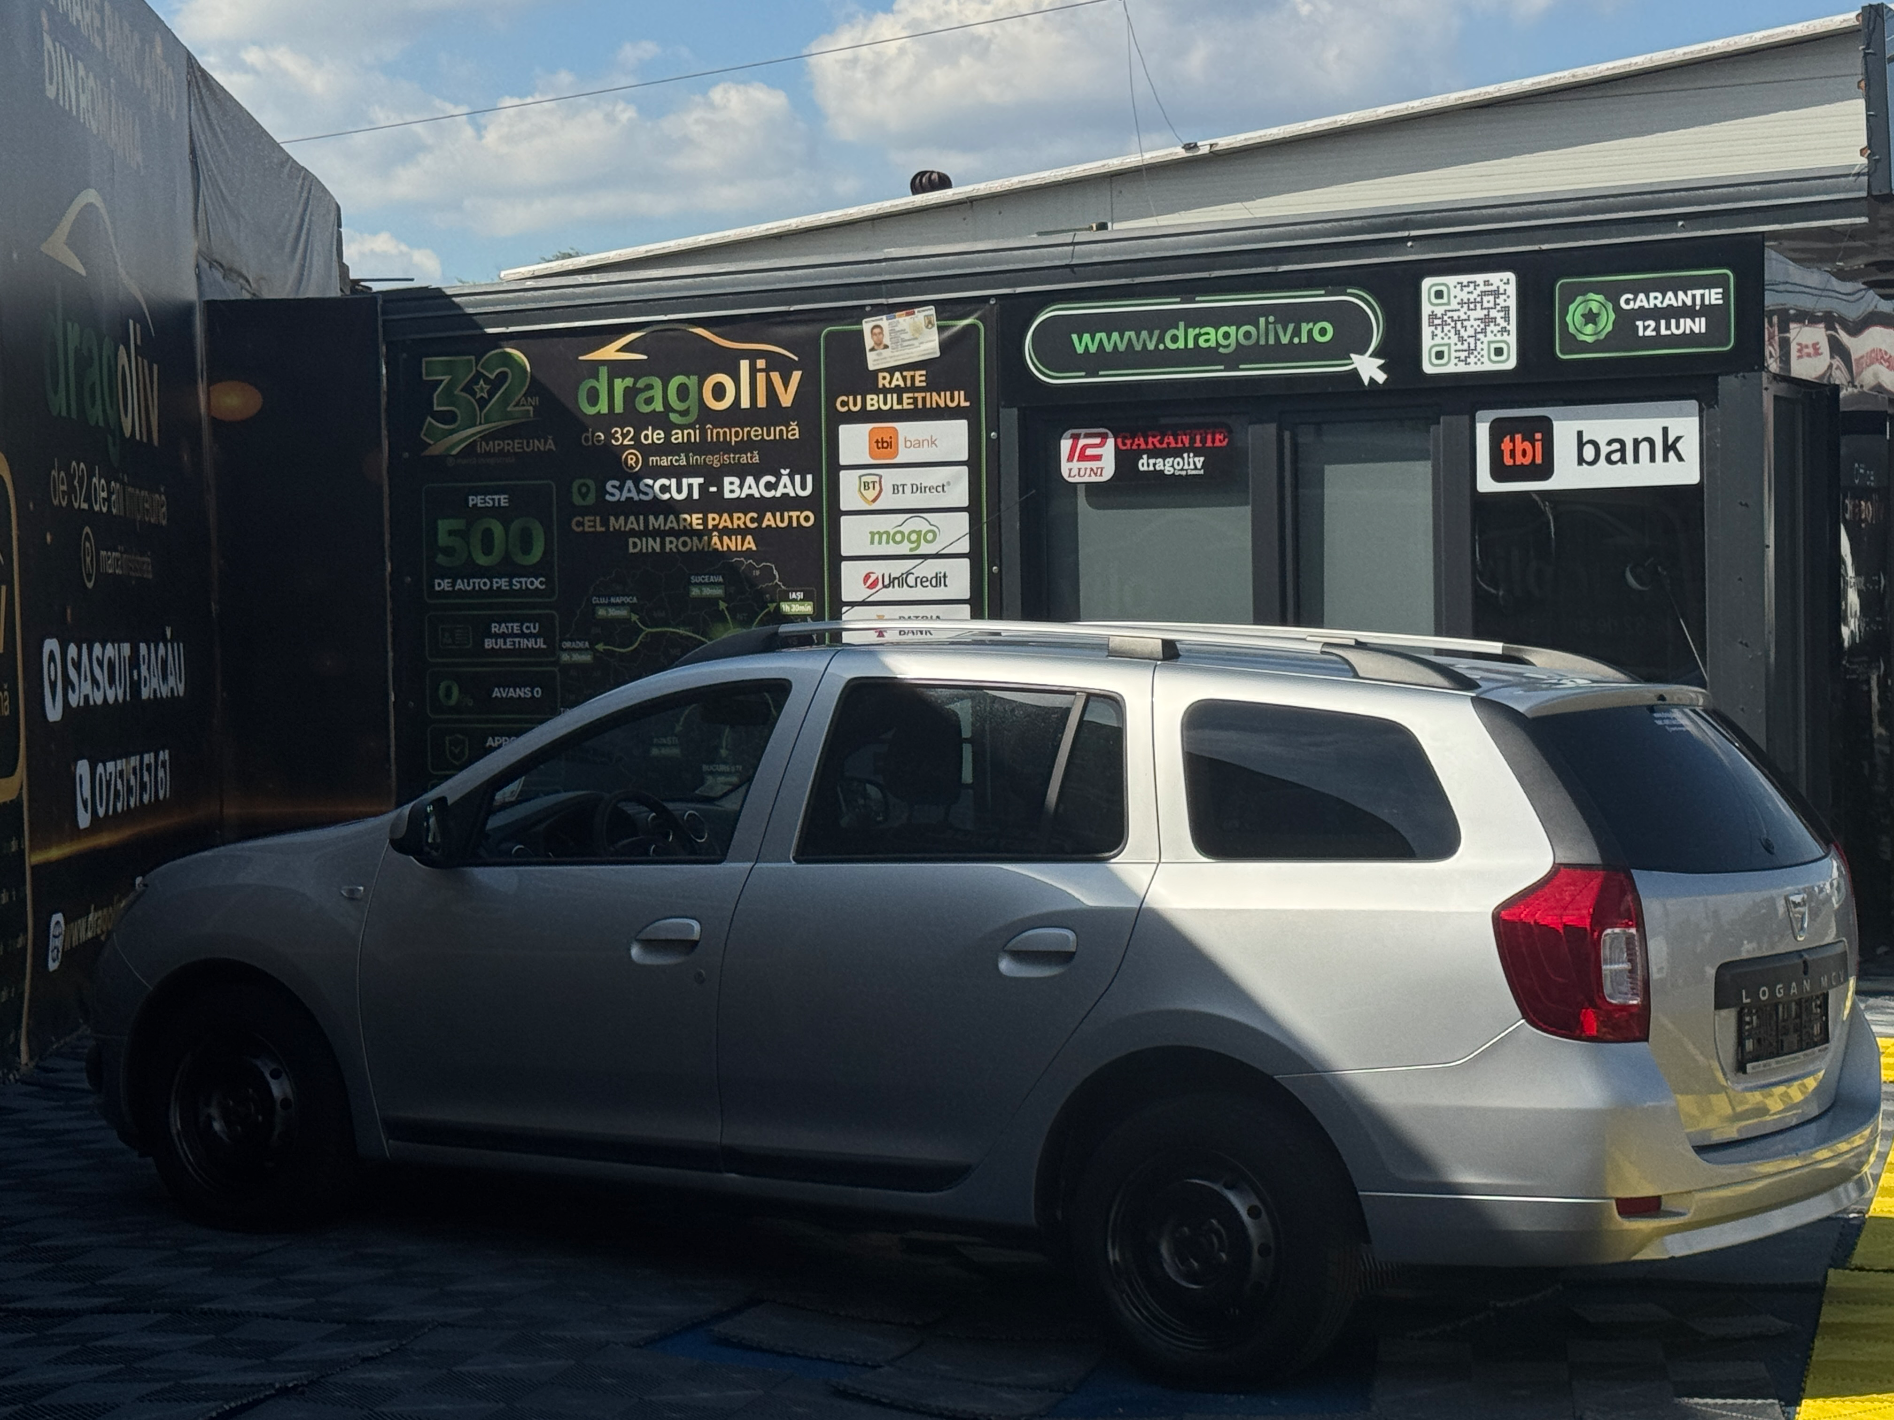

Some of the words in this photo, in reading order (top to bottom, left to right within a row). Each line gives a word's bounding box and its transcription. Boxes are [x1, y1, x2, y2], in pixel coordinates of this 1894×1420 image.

[43, 31, 76, 117] DIN
[1618, 288, 1724, 311] GARANȚIE
[1070, 315, 1334, 356] www.dragoliv.ro
[1635, 319, 1657, 337] 12
[1659, 316, 1707, 336] LUNI
[45, 283, 158, 468] dragoliv
[877, 370, 927, 389] RATE
[420, 347, 532, 445] 32
[577, 358, 803, 425] dragoliv
[835, 394, 862, 412] CU
[865, 390, 971, 411] BULETINUL
[476, 435, 557, 454] ÎMPREUNĂ
[581, 427, 605, 447] de
[610, 426, 636, 446] 32
[640, 425, 666, 445] de
[670, 424, 700, 444] ani
[705, 420, 800, 446] împreună
[873, 435, 893, 450] tbi
[903, 434, 939, 449] bank
[1066, 432, 1109, 463] 12
[1500, 432, 1544, 467] tbi
[1575, 426, 1687, 467] bank
[648, 452, 687, 468] marcă
[688, 450, 760, 468] înregistrată
[1138, 452, 1206, 476] dragoliv
[1067, 466, 1106, 479] LUNI
[50, 457, 68, 508] de
[70, 460, 89, 511] 32
[91, 464, 108, 513] de
[604, 477, 705, 502] SASCUT
[708, 486, 719, 494] -
[723, 468, 814, 500] BACĂU
[863, 480, 878, 491] BT
[891, 483, 908, 495] BT
[468, 494, 510, 508] PESTE
[571, 516, 606, 532] CEL
[609, 514, 645, 531] MAI
[648, 512, 704, 531] MARE
[707, 511, 759, 530] PARC
[761, 510, 815, 529] AUTO
[435, 516, 546, 567] 500
[628, 536, 661, 554] DIN
[665, 531, 758, 553] ROMÂNIA
[868, 528, 938, 553] mogo
[434, 578, 453, 592] DE
[454, 578, 491, 591] AUTO
[492, 578, 510, 590] PE
[511, 577, 547, 590] STOC
[690, 575, 724, 583] SUCEAVA
[881, 570, 948, 589] UniCredit
[788, 591, 804, 601] IAȘI
[781, 604, 791, 612] 1h
[491, 622, 521, 634] RATE
[522, 622, 540, 634] CU
[484, 637, 548, 650] BULETINUL
[561, 640, 591, 649] ORADEA
[67, 641, 132, 708] SASCUT
[139, 626, 186, 700] BACĂU
[491, 687, 532, 699] AVANS
[533, 687, 542, 698] 0
[1741, 978, 1812, 1004] LOGAN
